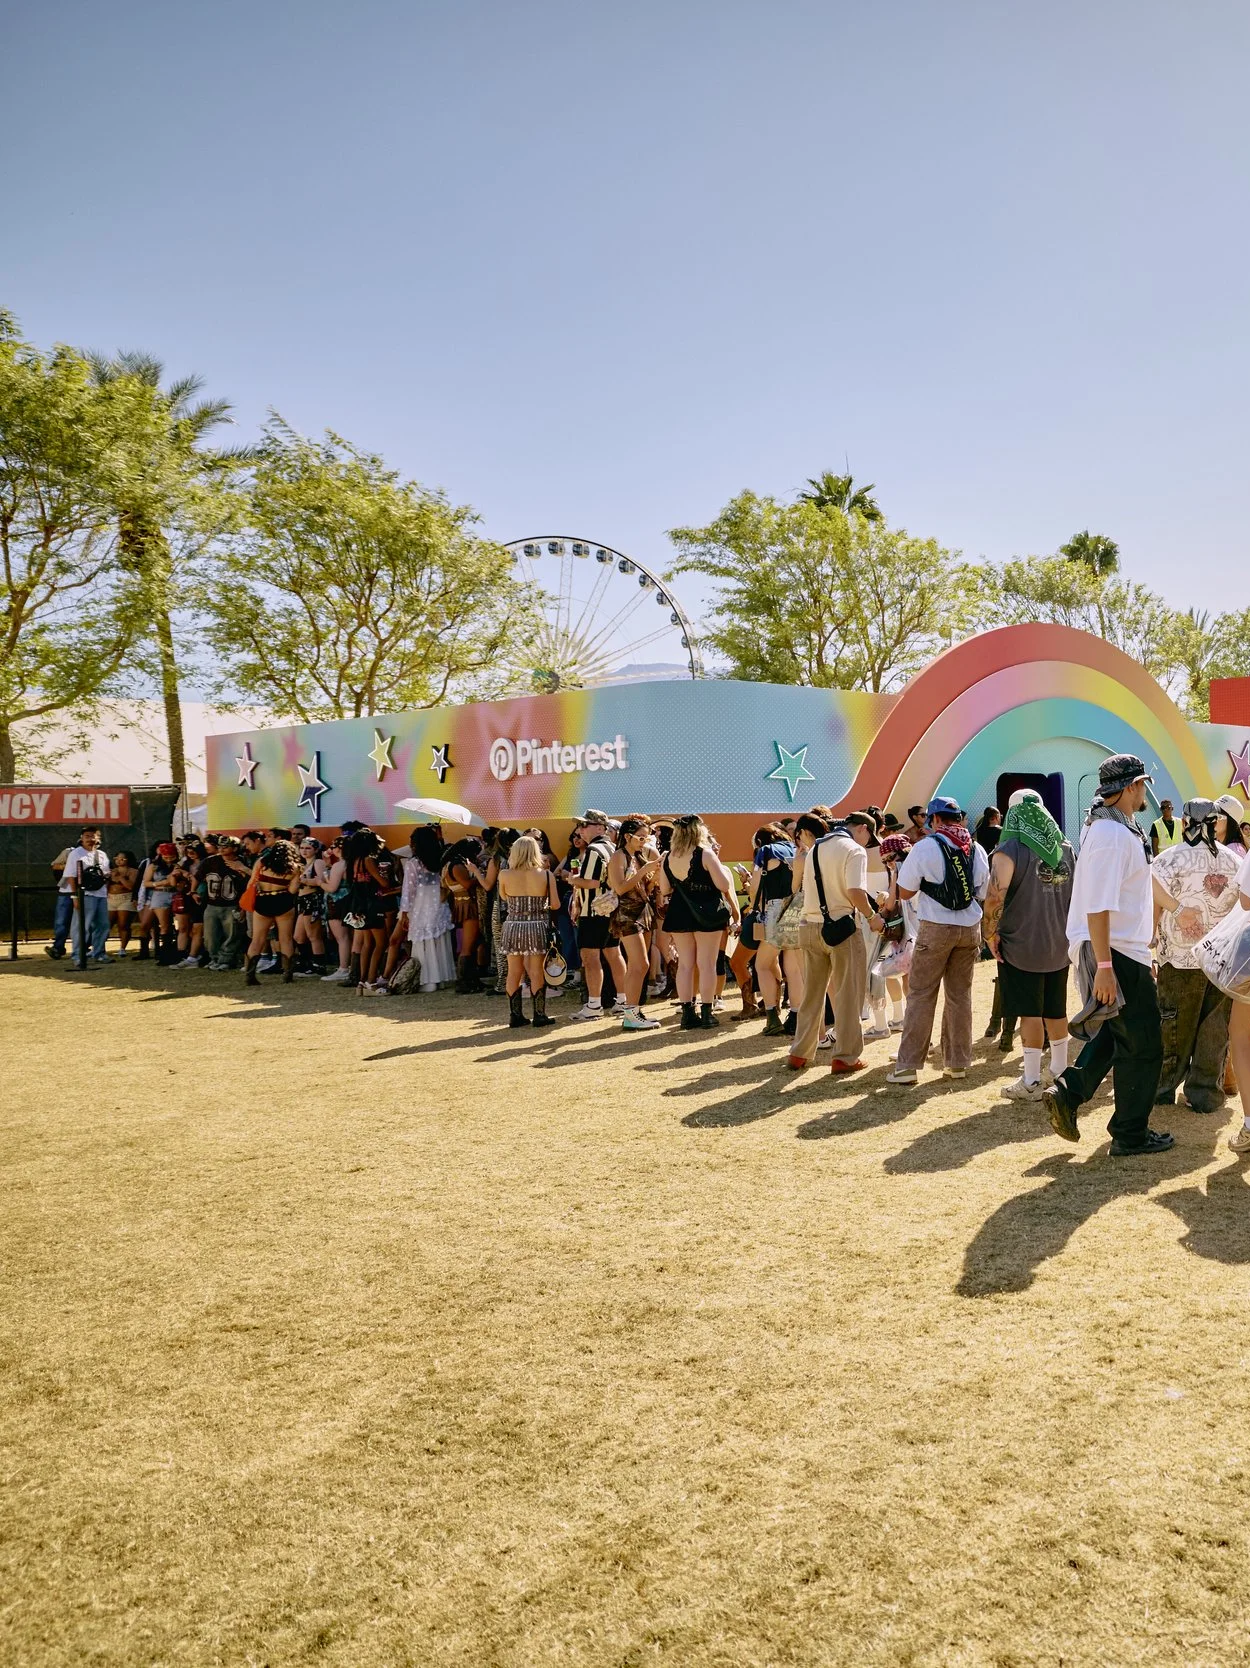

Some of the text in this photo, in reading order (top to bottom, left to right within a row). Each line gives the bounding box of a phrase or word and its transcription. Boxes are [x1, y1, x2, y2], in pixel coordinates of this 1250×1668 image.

[516, 734, 629, 776] Pinterest
[62, 793, 123, 819] EXIT
[952, 855, 971, 902] NATHAN
